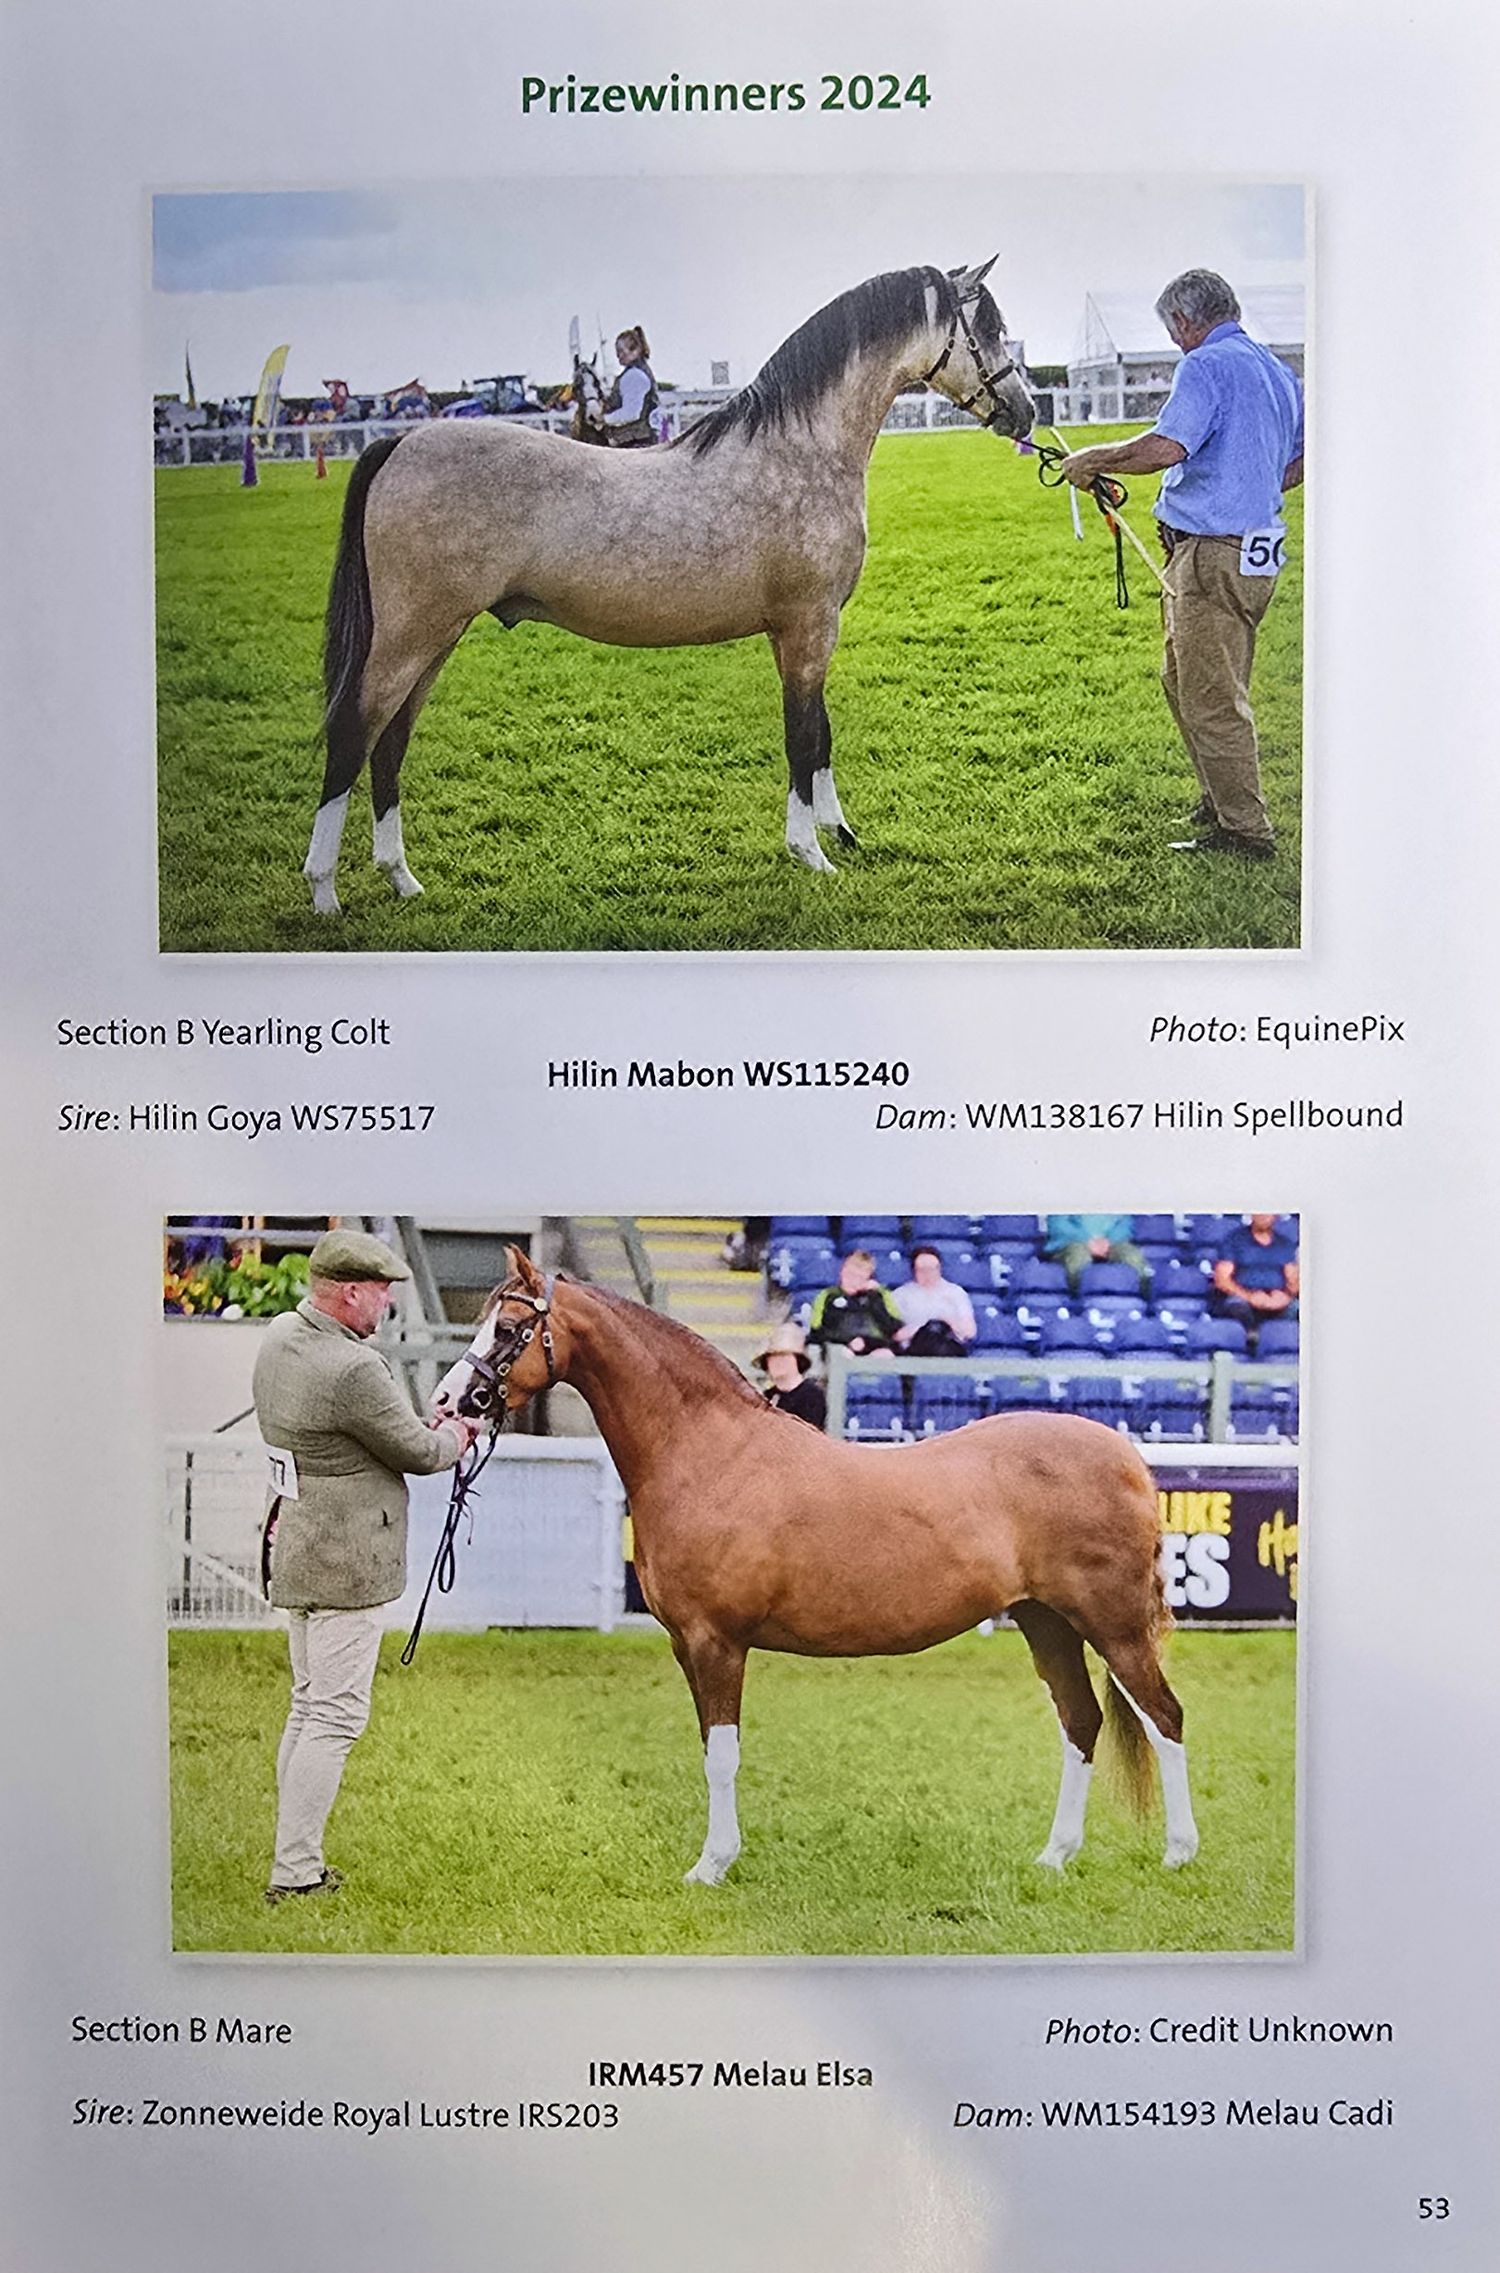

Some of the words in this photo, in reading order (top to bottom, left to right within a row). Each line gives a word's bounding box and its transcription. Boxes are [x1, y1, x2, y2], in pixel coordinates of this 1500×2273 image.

[522, 72, 806, 114] Prizewinners
[820, 73, 932, 111] 2024
[57, 1018, 167, 1048] Section
[177, 1019, 195, 1046] B
[201, 1017, 323, 1055] Yearling
[331, 1017, 391, 1046] Colt
[1149, 1014, 1247, 1043] Photo:
[1257, 1014, 1405, 1051] EquinePix
[548, 1059, 618, 1090] Hilin
[626, 1059, 734, 1088] Mabon
[742, 1060, 910, 1087] WS115240
[57, 1103, 120, 1131] Sire:
[130, 1102, 198, 1131] Hilin
[207, 1104, 282, 1140] Goya
[290, 1104, 436, 1132] WS75517
[875, 1103, 957, 1130] Dam:
[964, 1103, 1144, 1130] WM138167
[1154, 1100, 1223, 1129] Hilin
[1233, 1099, 1403, 1137] Spellbound
[71, 2015, 180, 2044] Section
[189, 2016, 208, 2043] B
[215, 2017, 292, 2046] Mare
[1045, 2017, 1141, 2045] Photo:
[1149, 2015, 1240, 2044] Credit
[1248, 2014, 1393, 2043] Unknown
[589, 2061, 704, 2089] IRM457
[713, 2059, 807, 2087] Melau
[816, 2060, 873, 2087] Elsa
[72, 2097, 134, 2126] Sire:
[142, 2099, 324, 2127] Zonneweide
[333, 2100, 410, 2136] Royal
[420, 2102, 510, 2128] Lustre
[519, 2102, 619, 2129] IRS203
[952, 2102, 1033, 2128] Dam:
[1040, 2100, 1216, 2127] WM154193
[1225, 2098, 1319, 2126] Melau
[1328, 2098, 1393, 2127] Cadi
[1418, 2197, 1450, 2220] 53
